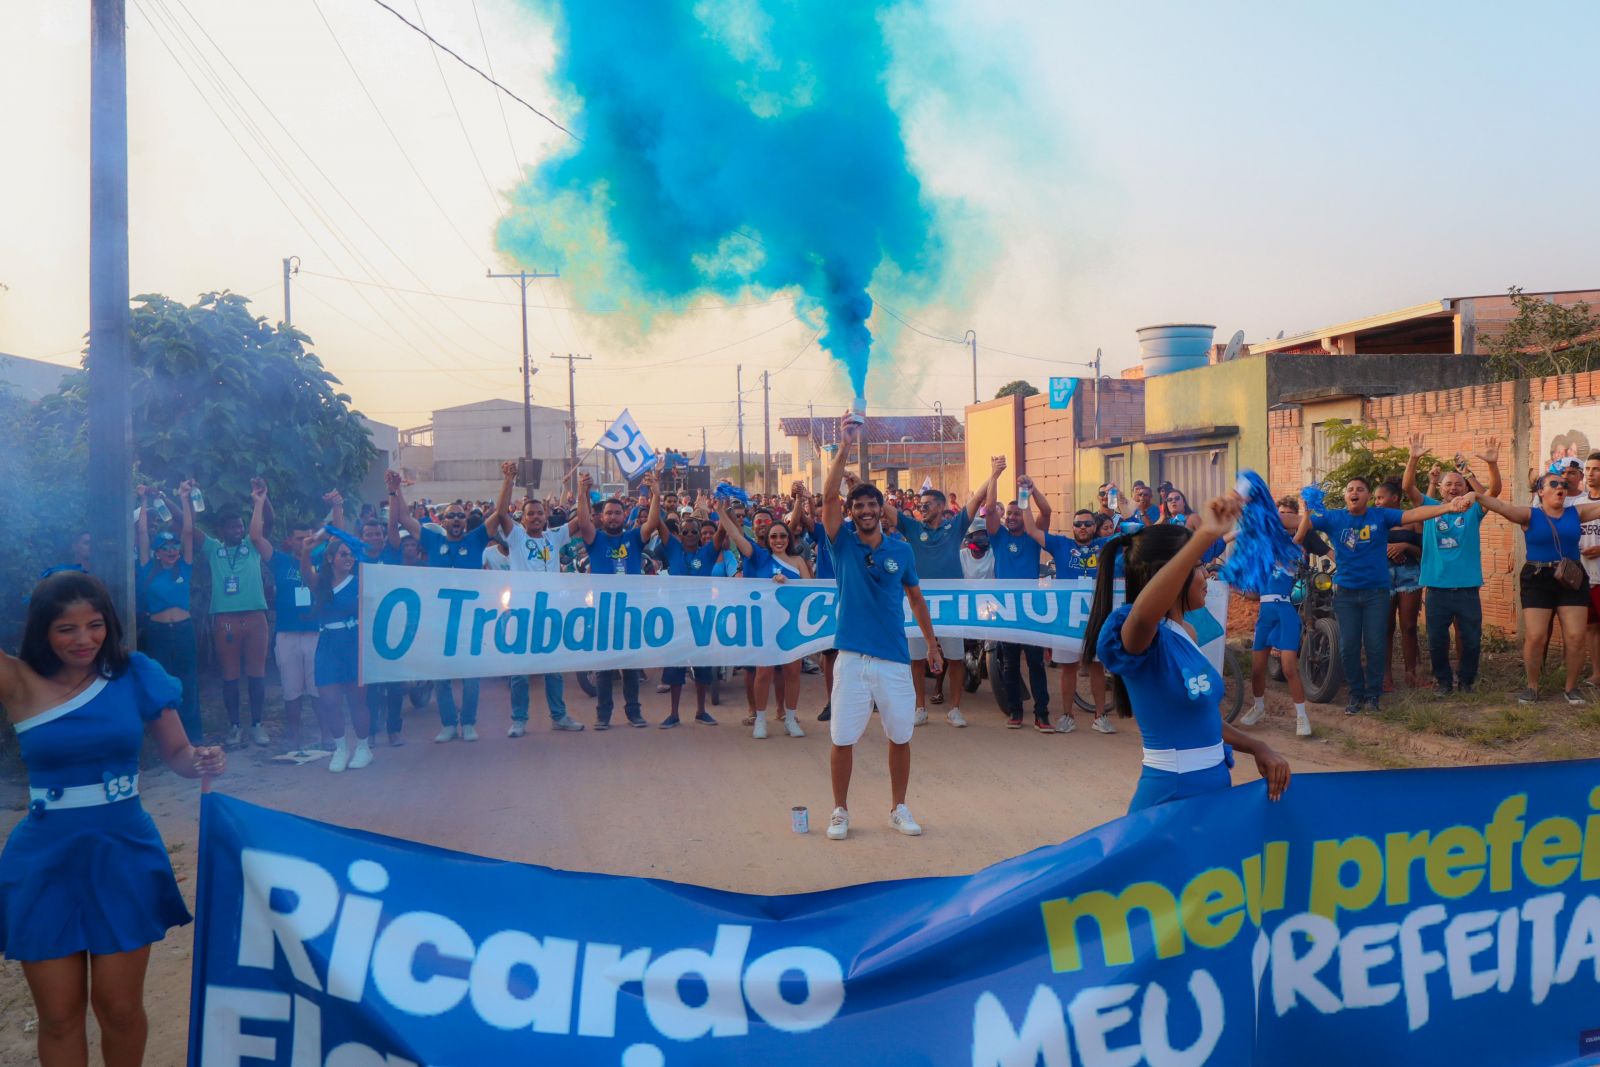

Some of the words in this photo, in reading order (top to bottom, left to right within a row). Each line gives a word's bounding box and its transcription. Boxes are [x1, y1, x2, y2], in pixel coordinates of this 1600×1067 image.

[600, 413, 657, 474] 55
[372, 587, 421, 661] O
[437, 588, 674, 656] Trabalho
[687, 591, 763, 648] vai
[797, 591, 1126, 637] CTINUA
[1189, 674, 1211, 695] 55
[109, 776, 131, 796] 55
[237, 847, 846, 1042] Ricardo
[972, 969, 1225, 1067] MEU
